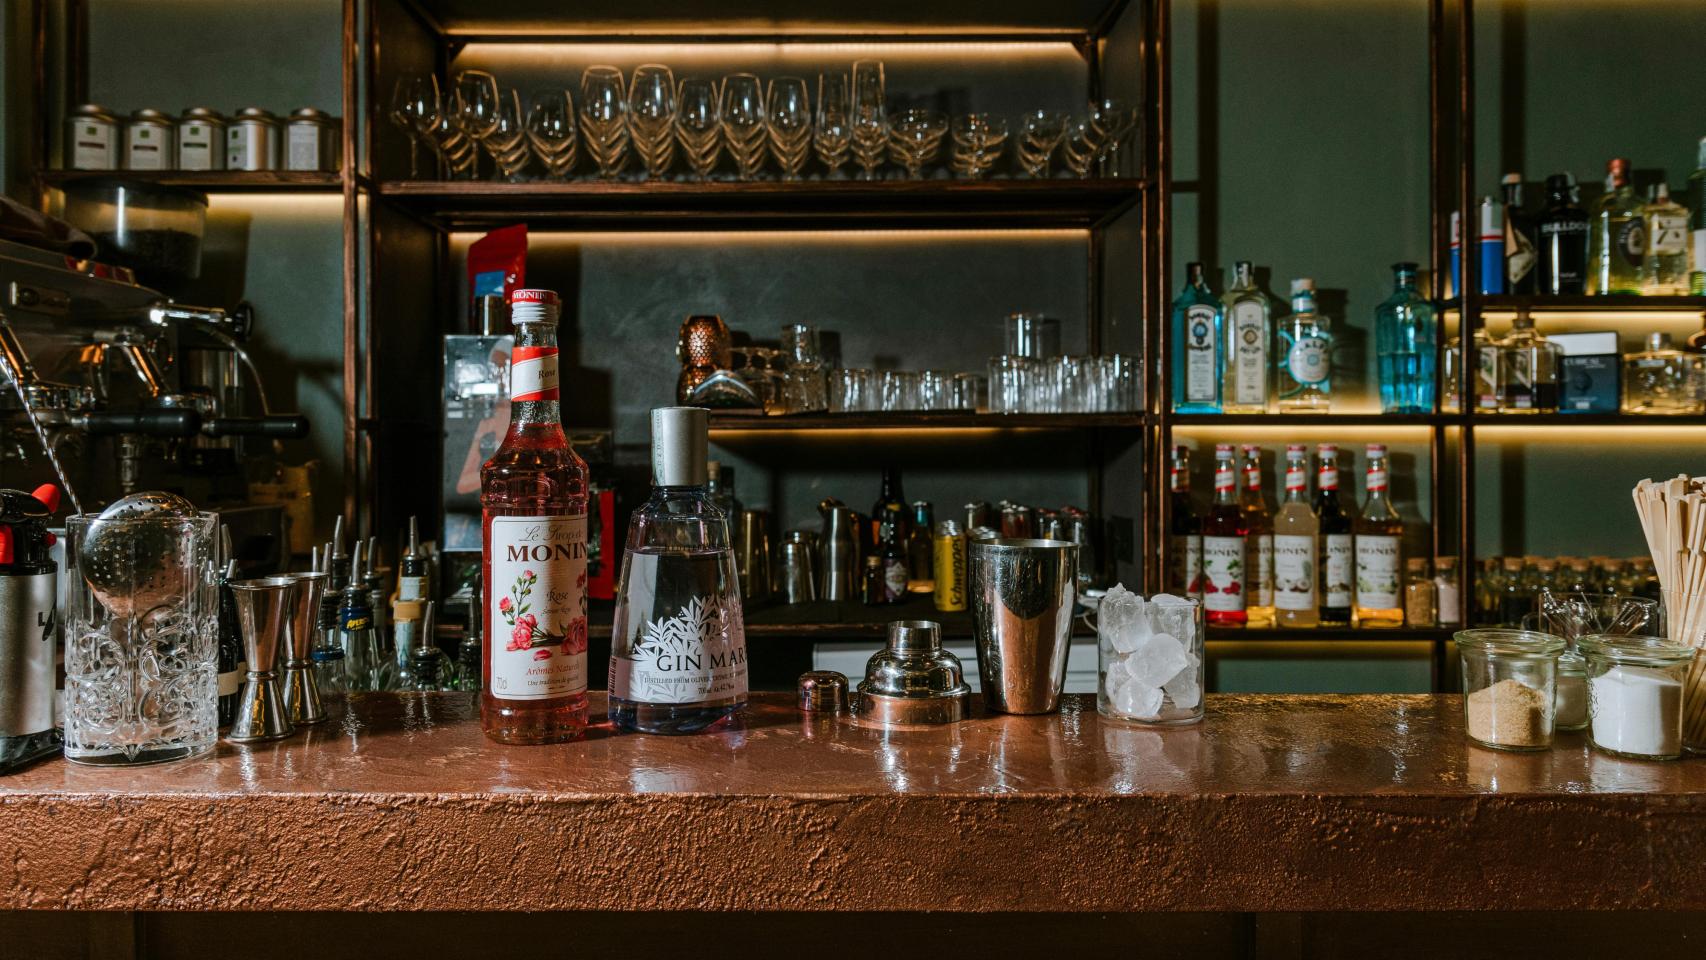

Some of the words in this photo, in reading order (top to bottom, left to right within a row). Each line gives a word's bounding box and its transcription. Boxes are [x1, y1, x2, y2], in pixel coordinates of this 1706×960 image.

[518, 525, 541, 542] Le
[950, 537, 963, 608] Schweppes
[546, 587, 569, 605] Rose
[656, 654, 701, 672] GIN
